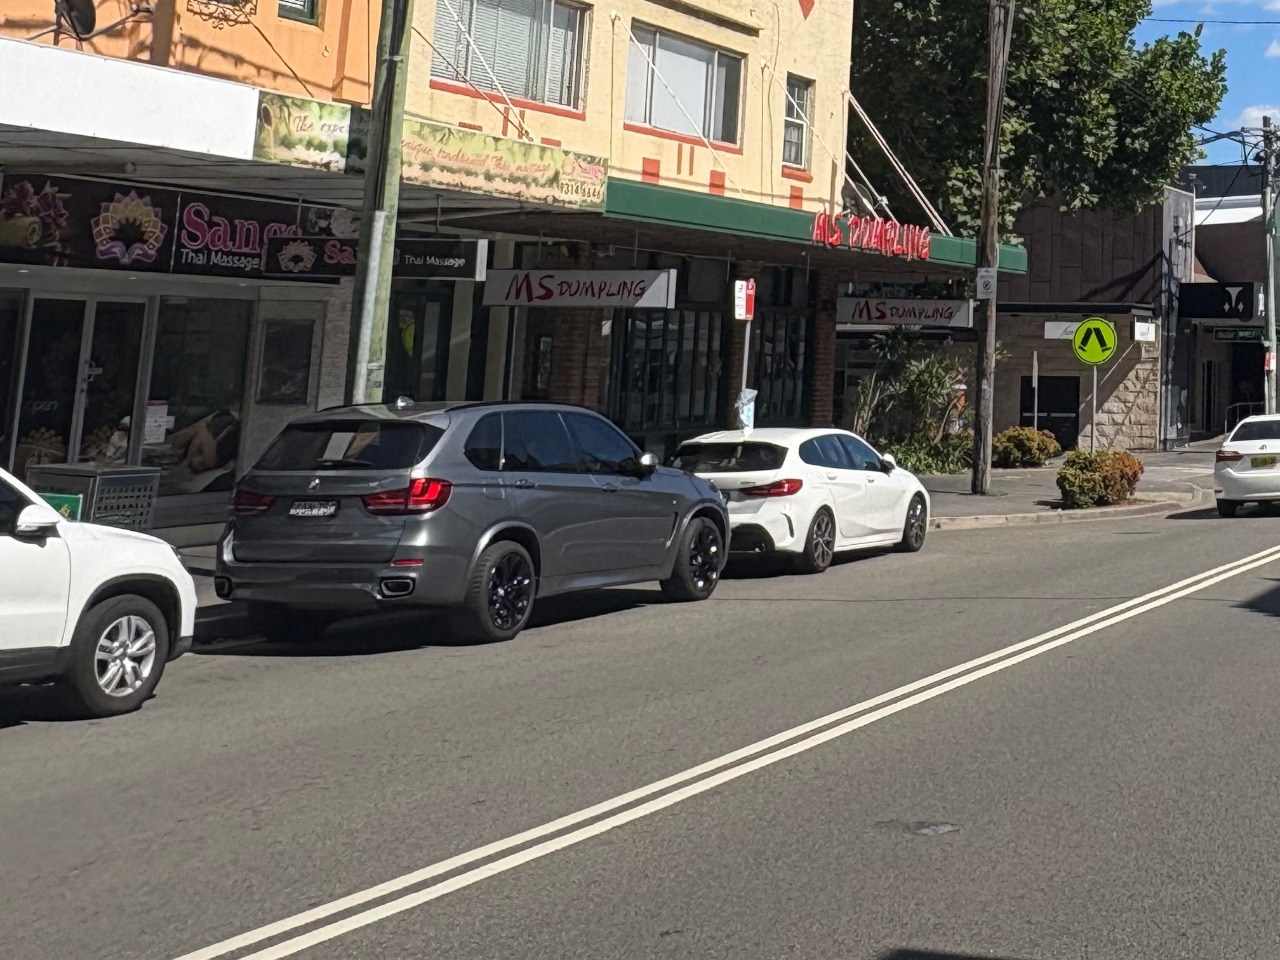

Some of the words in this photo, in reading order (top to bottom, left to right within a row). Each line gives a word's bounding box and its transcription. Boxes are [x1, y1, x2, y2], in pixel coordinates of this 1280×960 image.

[812, 211, 844, 247] MS
[848, 215, 933, 262] DUMPLING
[180, 248, 207, 265] Thai
[209, 250, 260, 271] Massage
[403, 254, 425, 265] Thai
[425, 254, 466, 268] Massage
[505, 271, 555, 303] MS
[557, 279, 646, 301] DUMPLING
[851, 299, 887, 321] MS
[889, 304, 954, 321] DUMPLING
